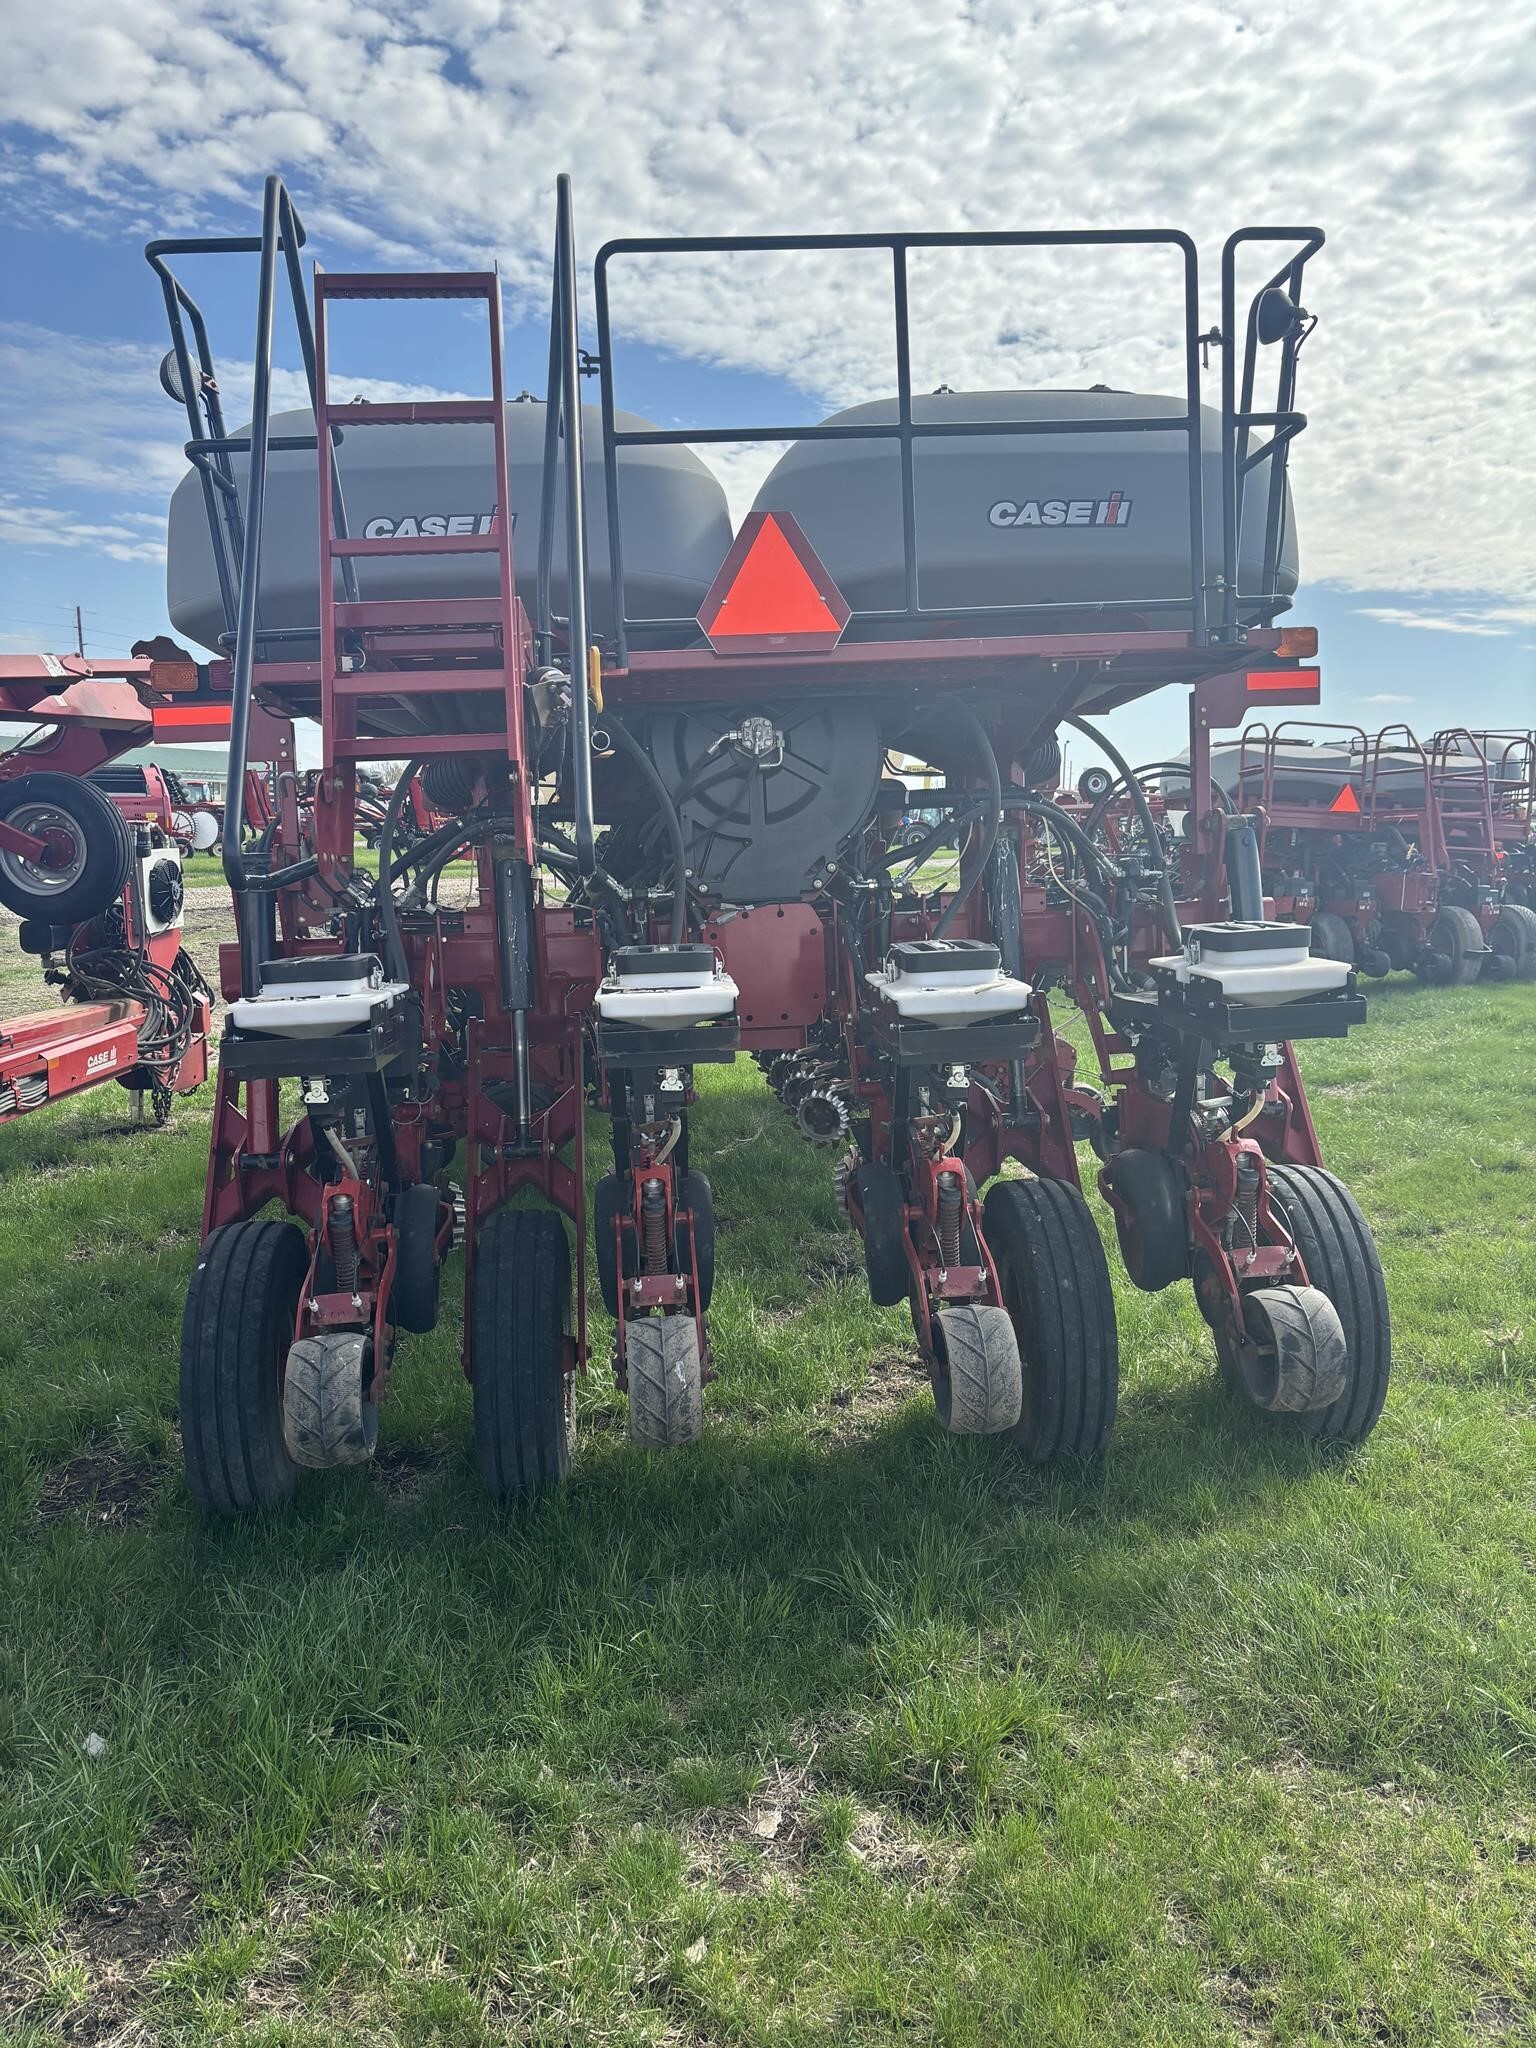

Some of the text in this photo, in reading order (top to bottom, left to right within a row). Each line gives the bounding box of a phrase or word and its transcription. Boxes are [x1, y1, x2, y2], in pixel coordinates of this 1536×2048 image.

[989, 501, 1093, 526] CASE
[365, 516, 475, 539] CASE
[87, 1050, 109, 1068] CASE
